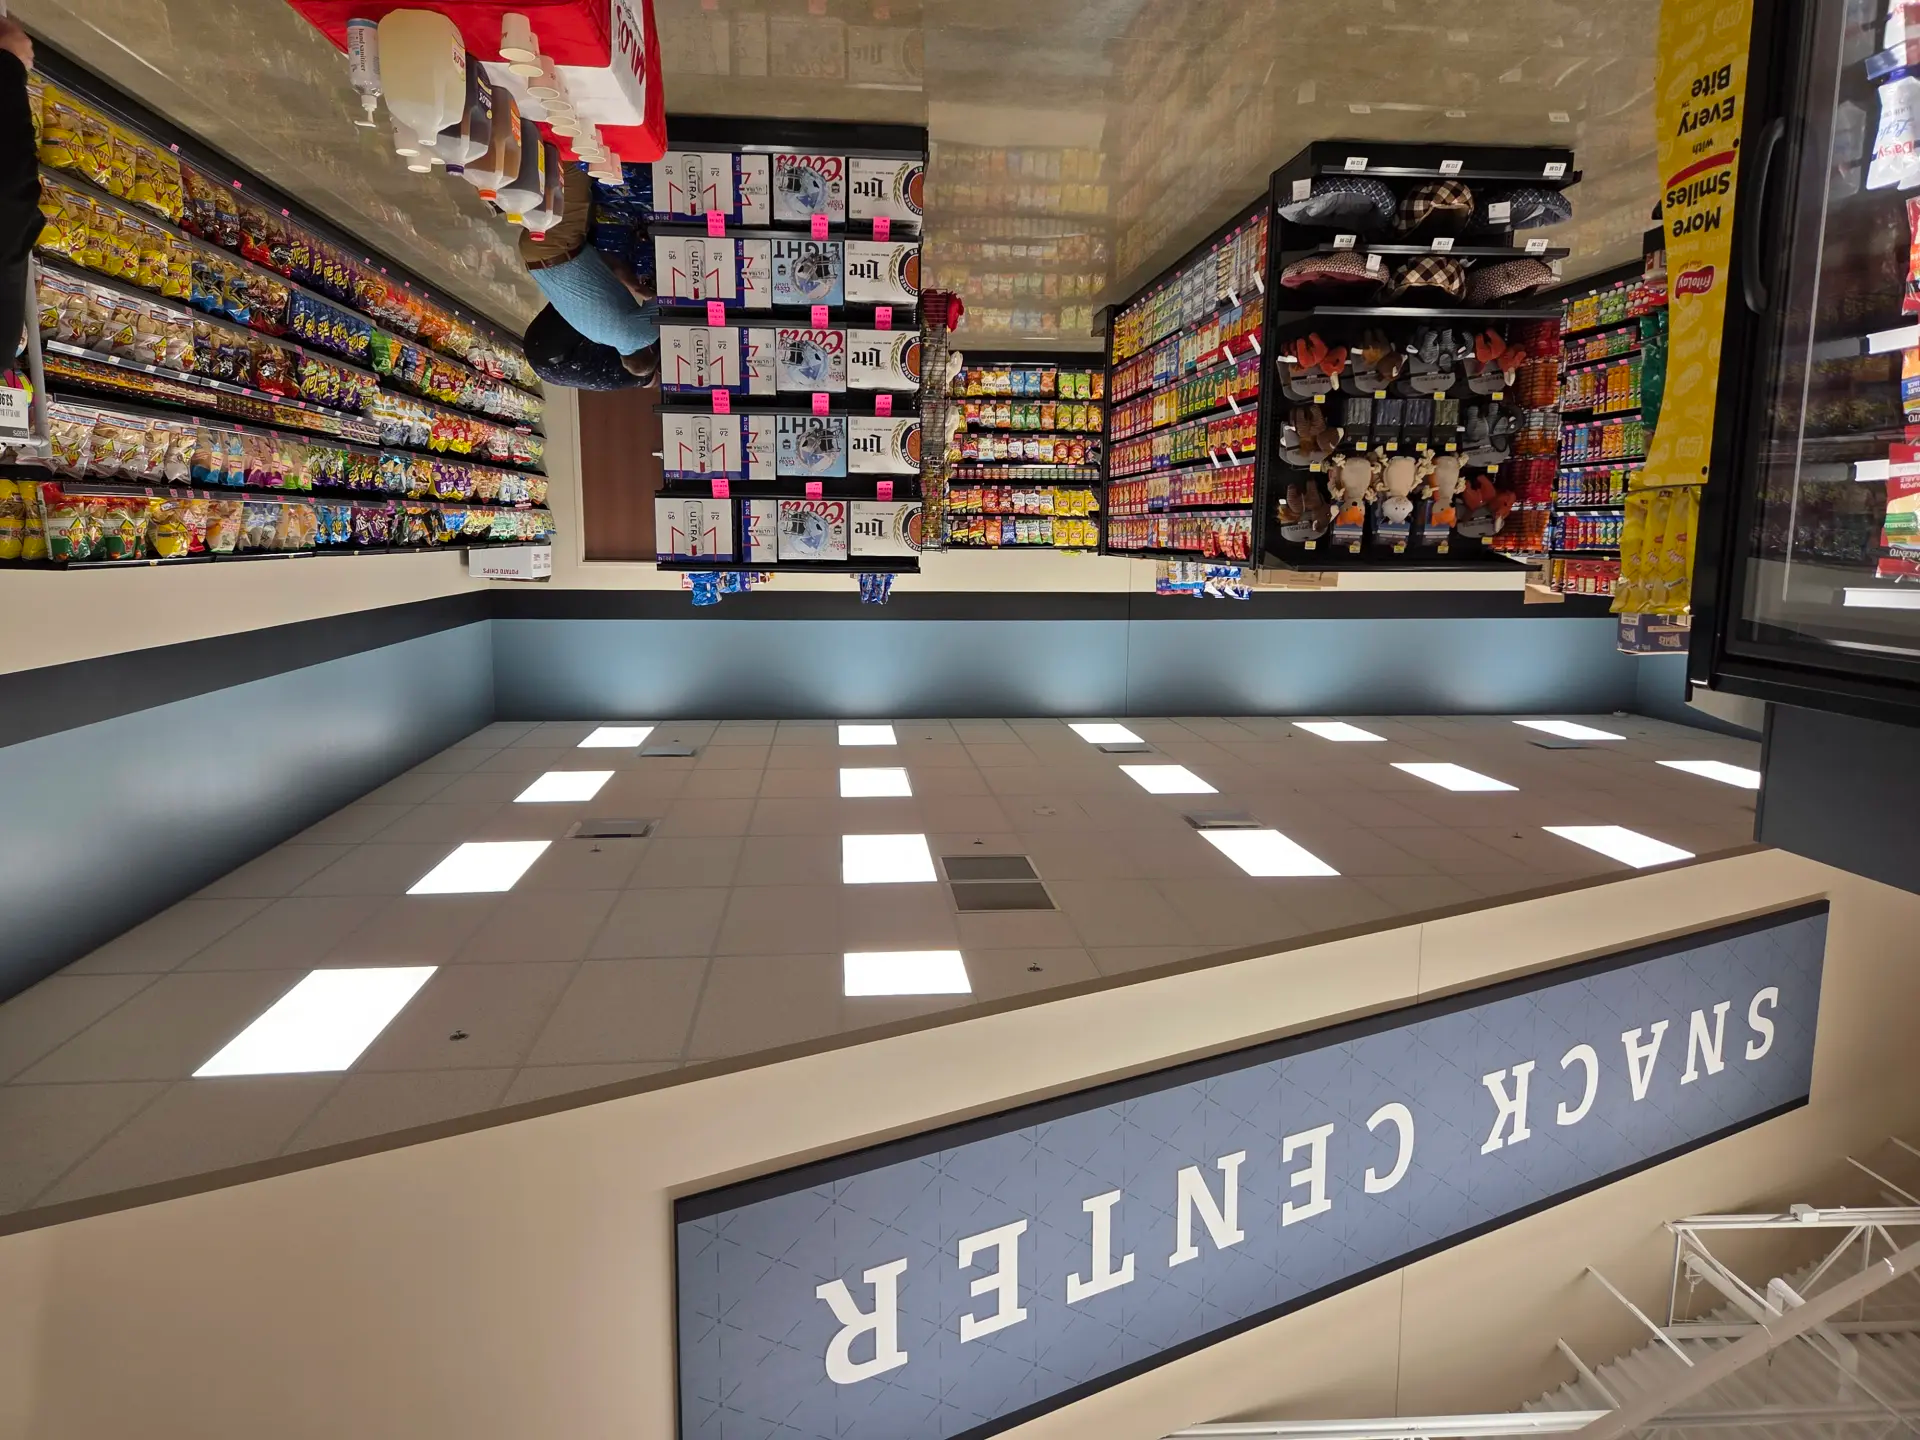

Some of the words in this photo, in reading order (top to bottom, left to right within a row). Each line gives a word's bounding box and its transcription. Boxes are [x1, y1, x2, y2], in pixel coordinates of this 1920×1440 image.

[1690, 64, 1732, 98] Bite
[1676, 94, 1736, 137] Every
[1692, 138, 1714, 155] with
[1878, 141, 1913, 159] Daisy
[776, 154, 842, 182] Coors
[688, 166, 696, 200] ULTRA
[853, 177, 883, 198] Lite
[1666, 170, 1732, 209] Smiles
[1672, 206, 1722, 238] More
[848, 260, 879, 279] Lite
[778, 329, 844, 356] Coors
[851, 348, 881, 368] Lite
[698, 427, 706, 459] ULTRA
[852, 434, 881, 453] Lite
[780, 501, 844, 524] Coors
[854, 518, 883, 536] Lite
[1481, 983, 1780, 1155] SNACK
[814, 1100, 1417, 1386] CENTER
